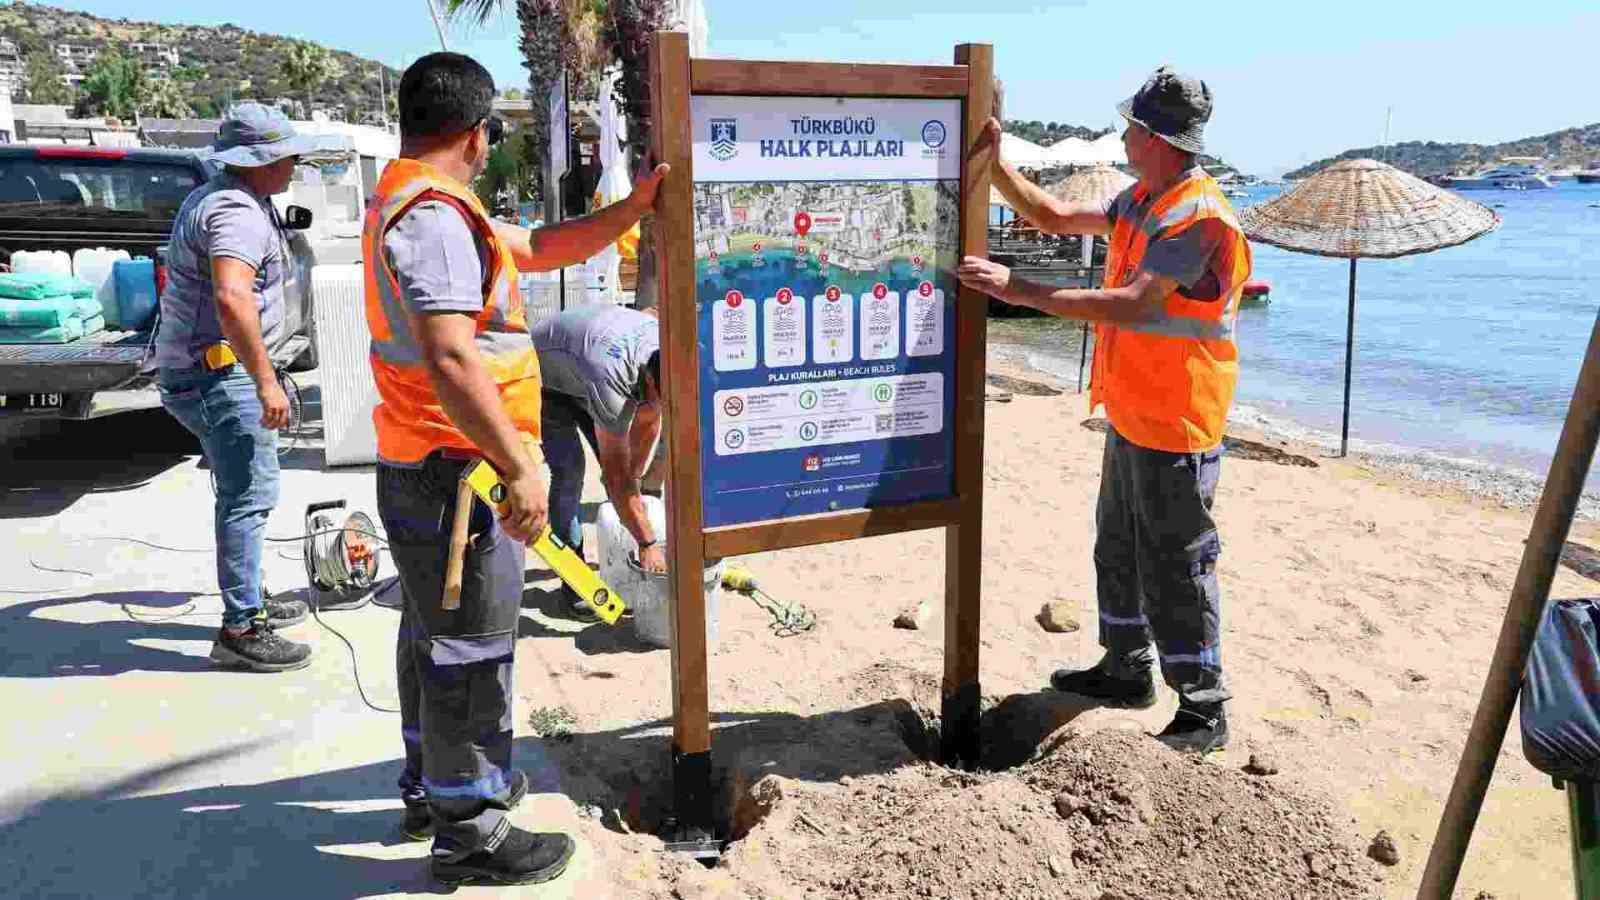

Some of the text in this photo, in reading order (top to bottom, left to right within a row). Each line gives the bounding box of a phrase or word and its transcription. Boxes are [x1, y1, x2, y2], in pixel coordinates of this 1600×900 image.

[790, 116, 876, 136] TÜRKBÜKÜ
[760, 139, 812, 158] HALK
[817, 139, 904, 157] PLAJLARI
[768, 373, 790, 384] PLAJ
[843, 366, 870, 376] BEACH
[872, 364, 897, 375] RULES
